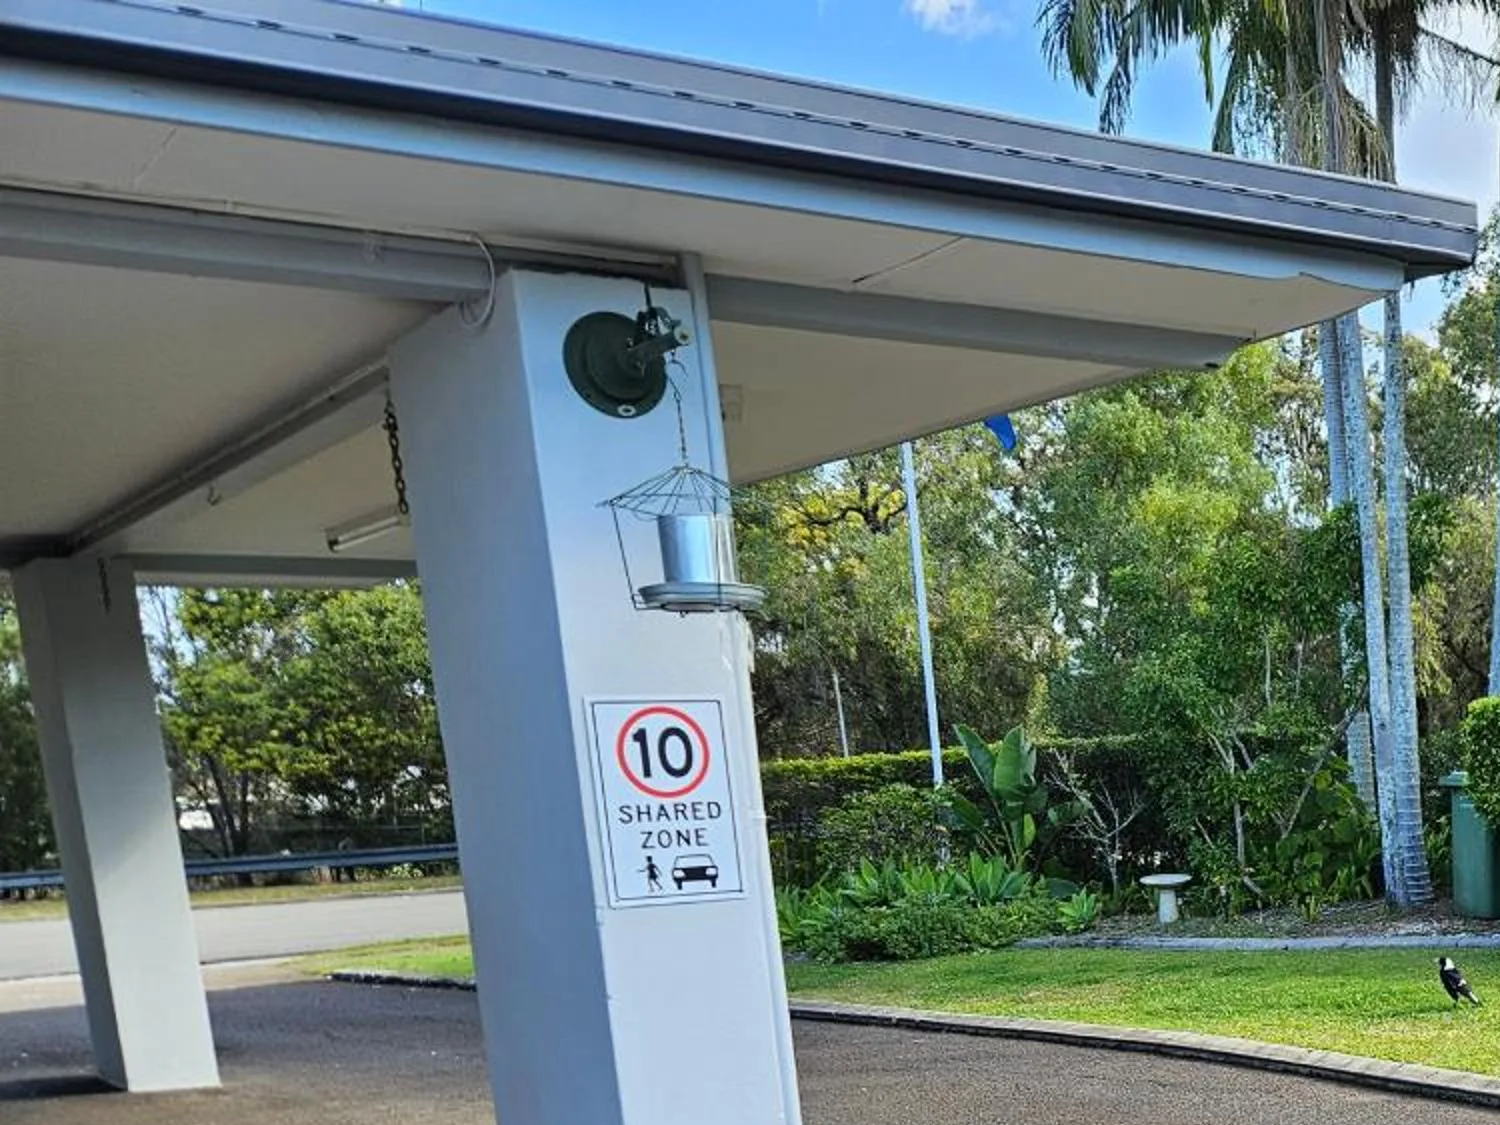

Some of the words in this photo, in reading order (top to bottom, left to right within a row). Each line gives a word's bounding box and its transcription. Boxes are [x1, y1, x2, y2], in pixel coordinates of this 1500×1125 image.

[632, 727, 693, 778] 10
[618, 801, 721, 824] SHARED
[640, 828, 710, 849] ZONE
